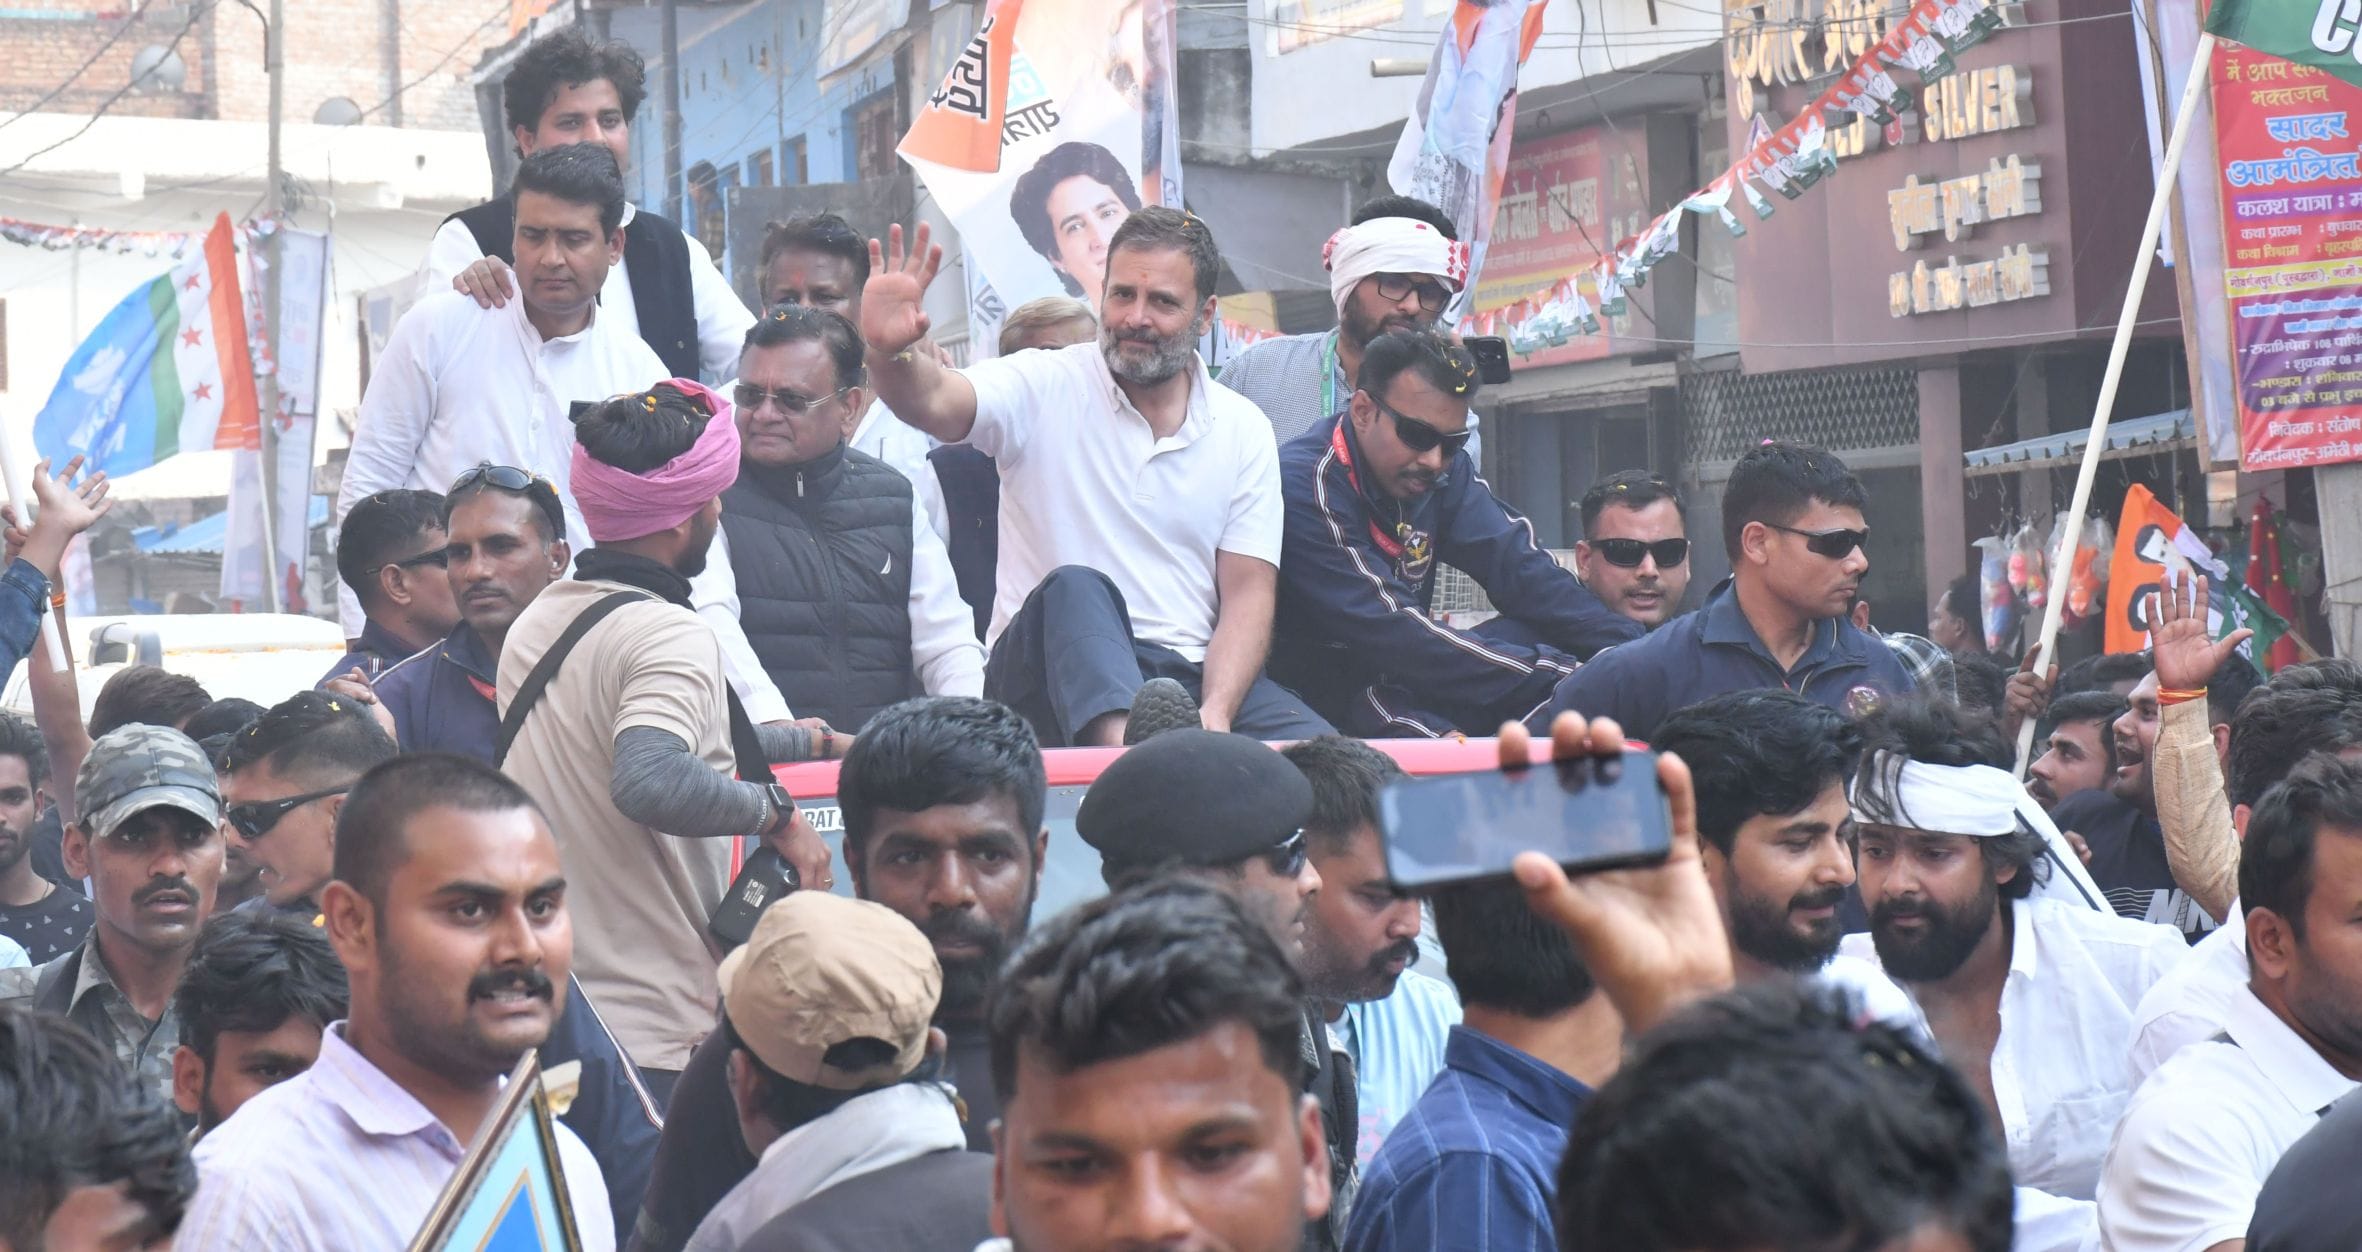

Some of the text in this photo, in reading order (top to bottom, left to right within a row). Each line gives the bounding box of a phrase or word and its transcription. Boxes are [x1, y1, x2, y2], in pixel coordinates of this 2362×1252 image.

[2225, 58, 2242, 83] में
[2247, 60, 2289, 82] आप
[1923, 64, 2018, 143] SILVER
[2250, 84, 2330, 107] भक्तजन
[2264, 111, 2350, 143] सादर
[2225, 145, 2361, 188] आमंत्रित
[2237, 197, 2289, 217] कलश
[2292, 194, 2334, 213] यात्रा
